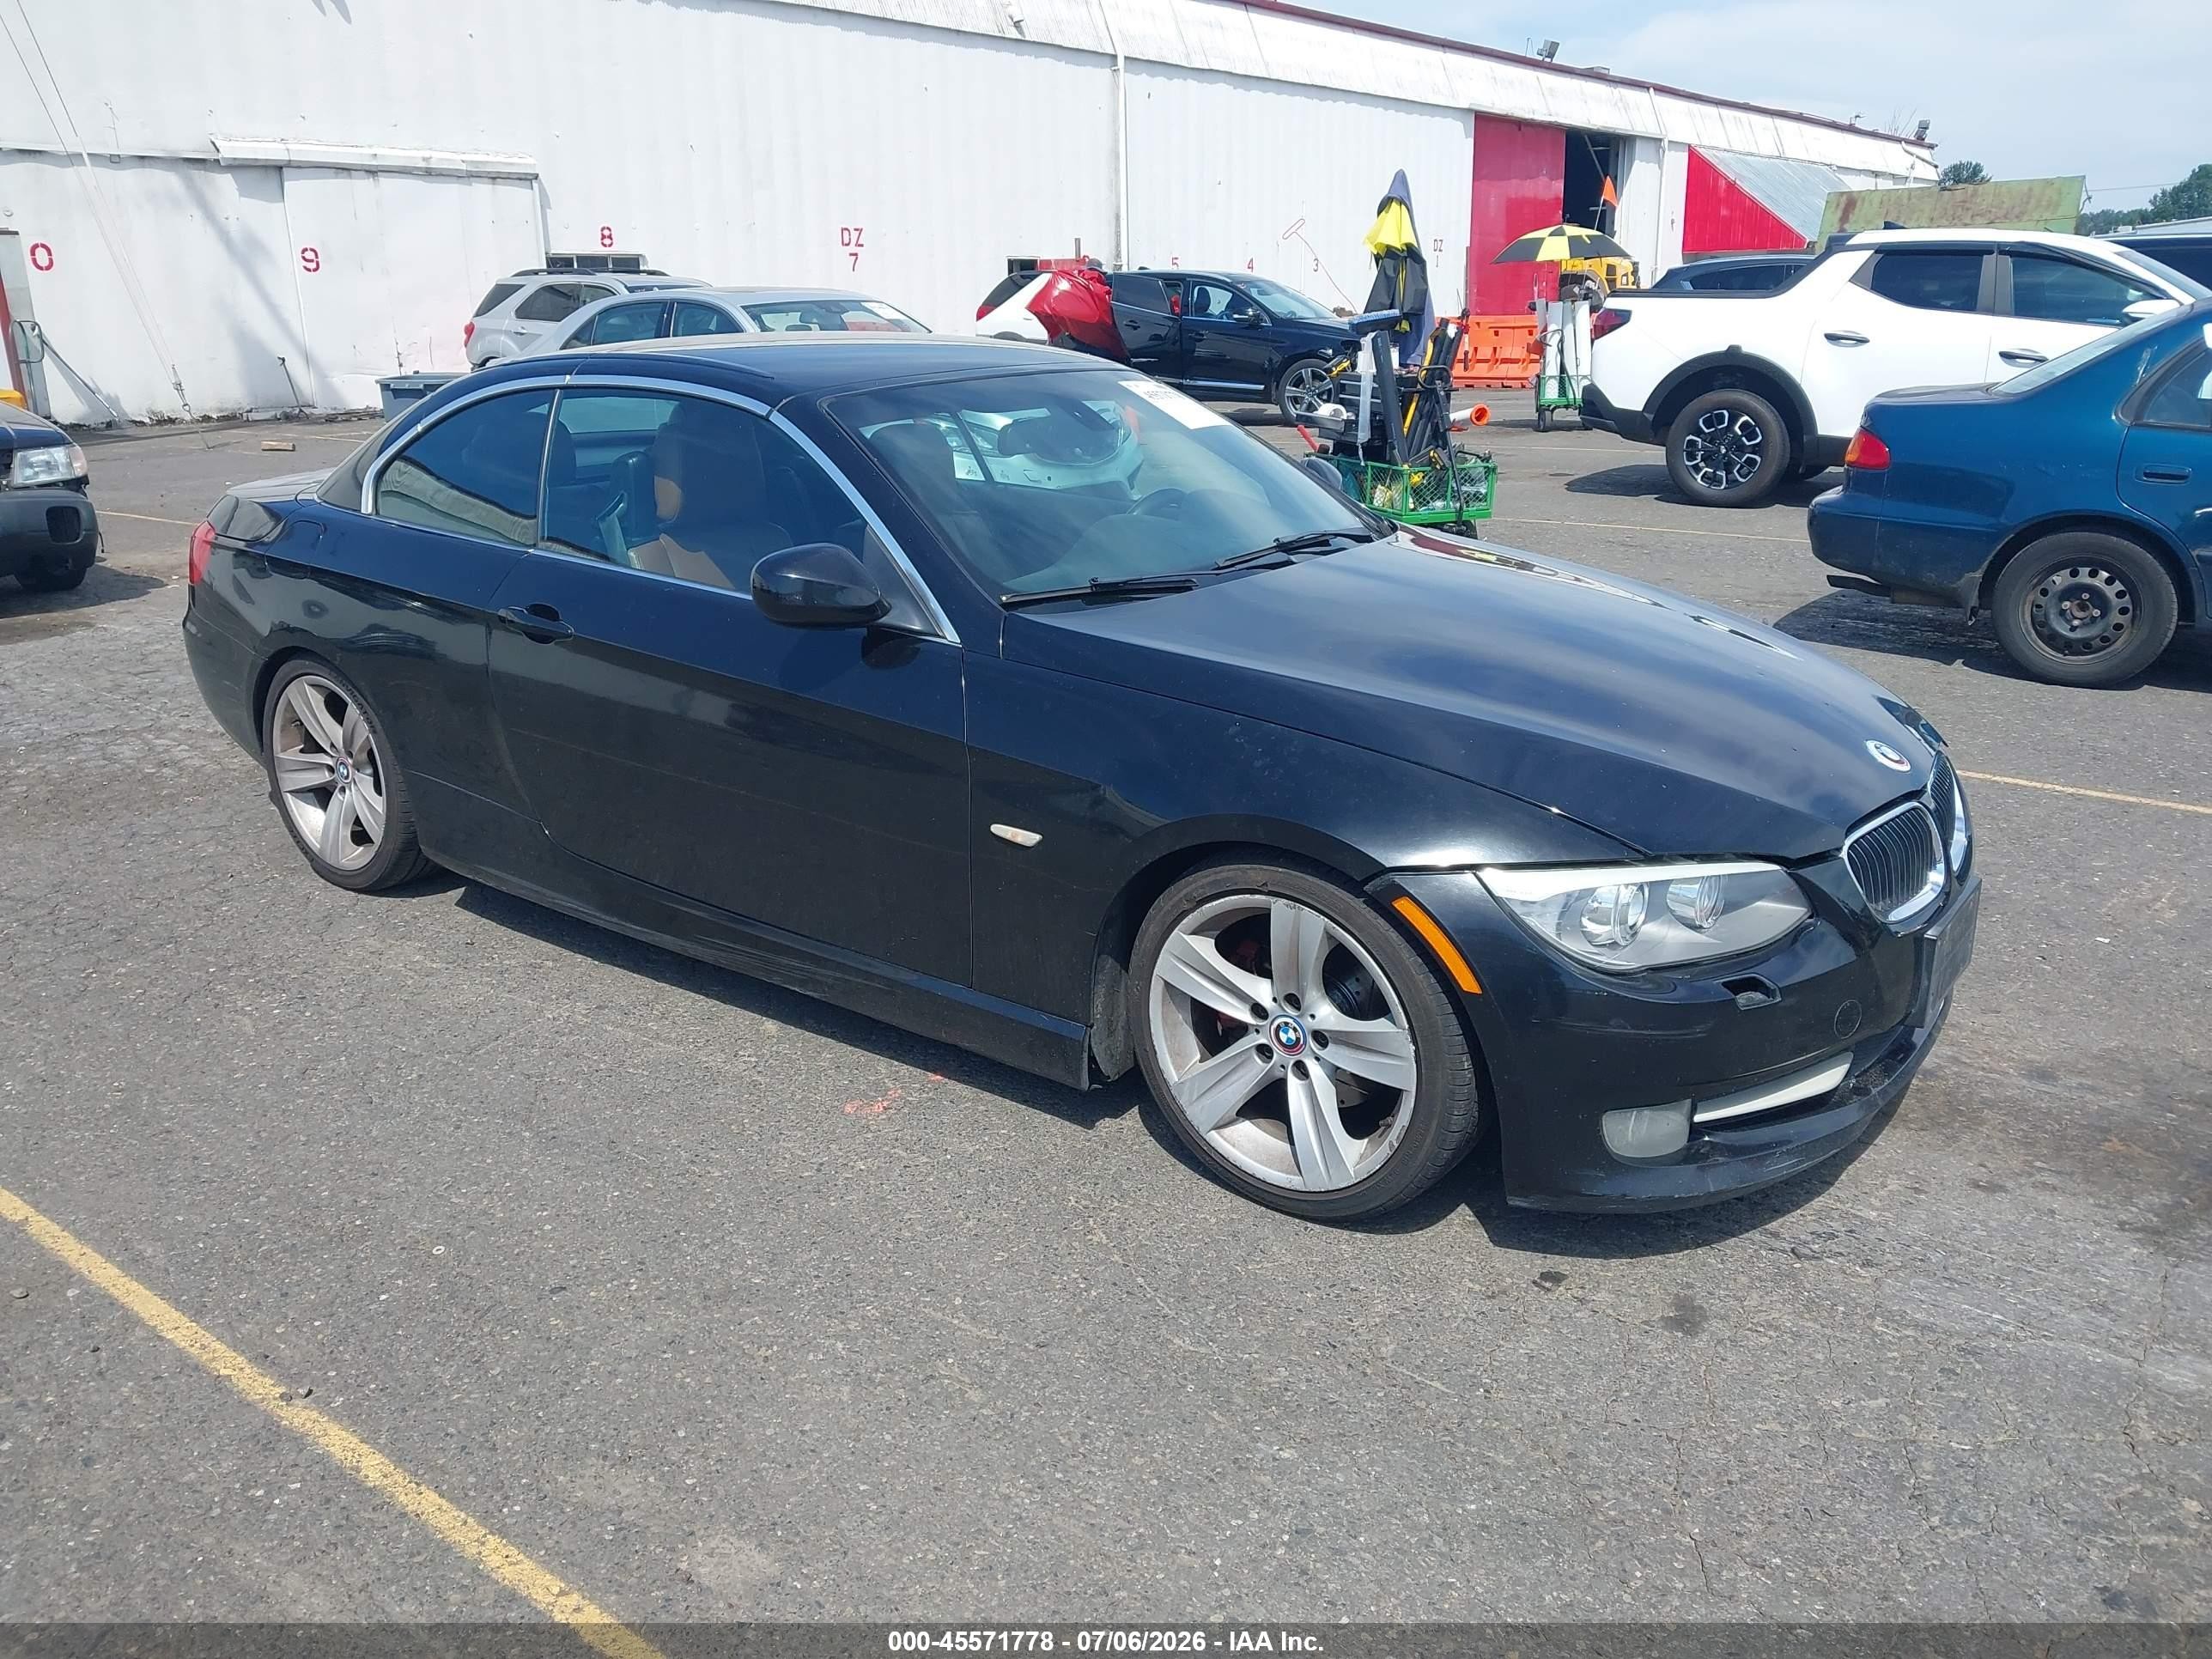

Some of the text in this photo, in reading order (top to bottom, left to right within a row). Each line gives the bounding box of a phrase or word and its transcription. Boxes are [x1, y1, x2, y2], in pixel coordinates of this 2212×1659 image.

[600, 226, 613, 247] 8
[841, 227, 864, 247] DZ
[1433, 239, 1443, 252] DZ
[301, 247, 319, 272] 9
[848, 252, 858, 271] 7
[1247, 257, 1254, 273] 4
[1313, 258, 1319, 272] 3
